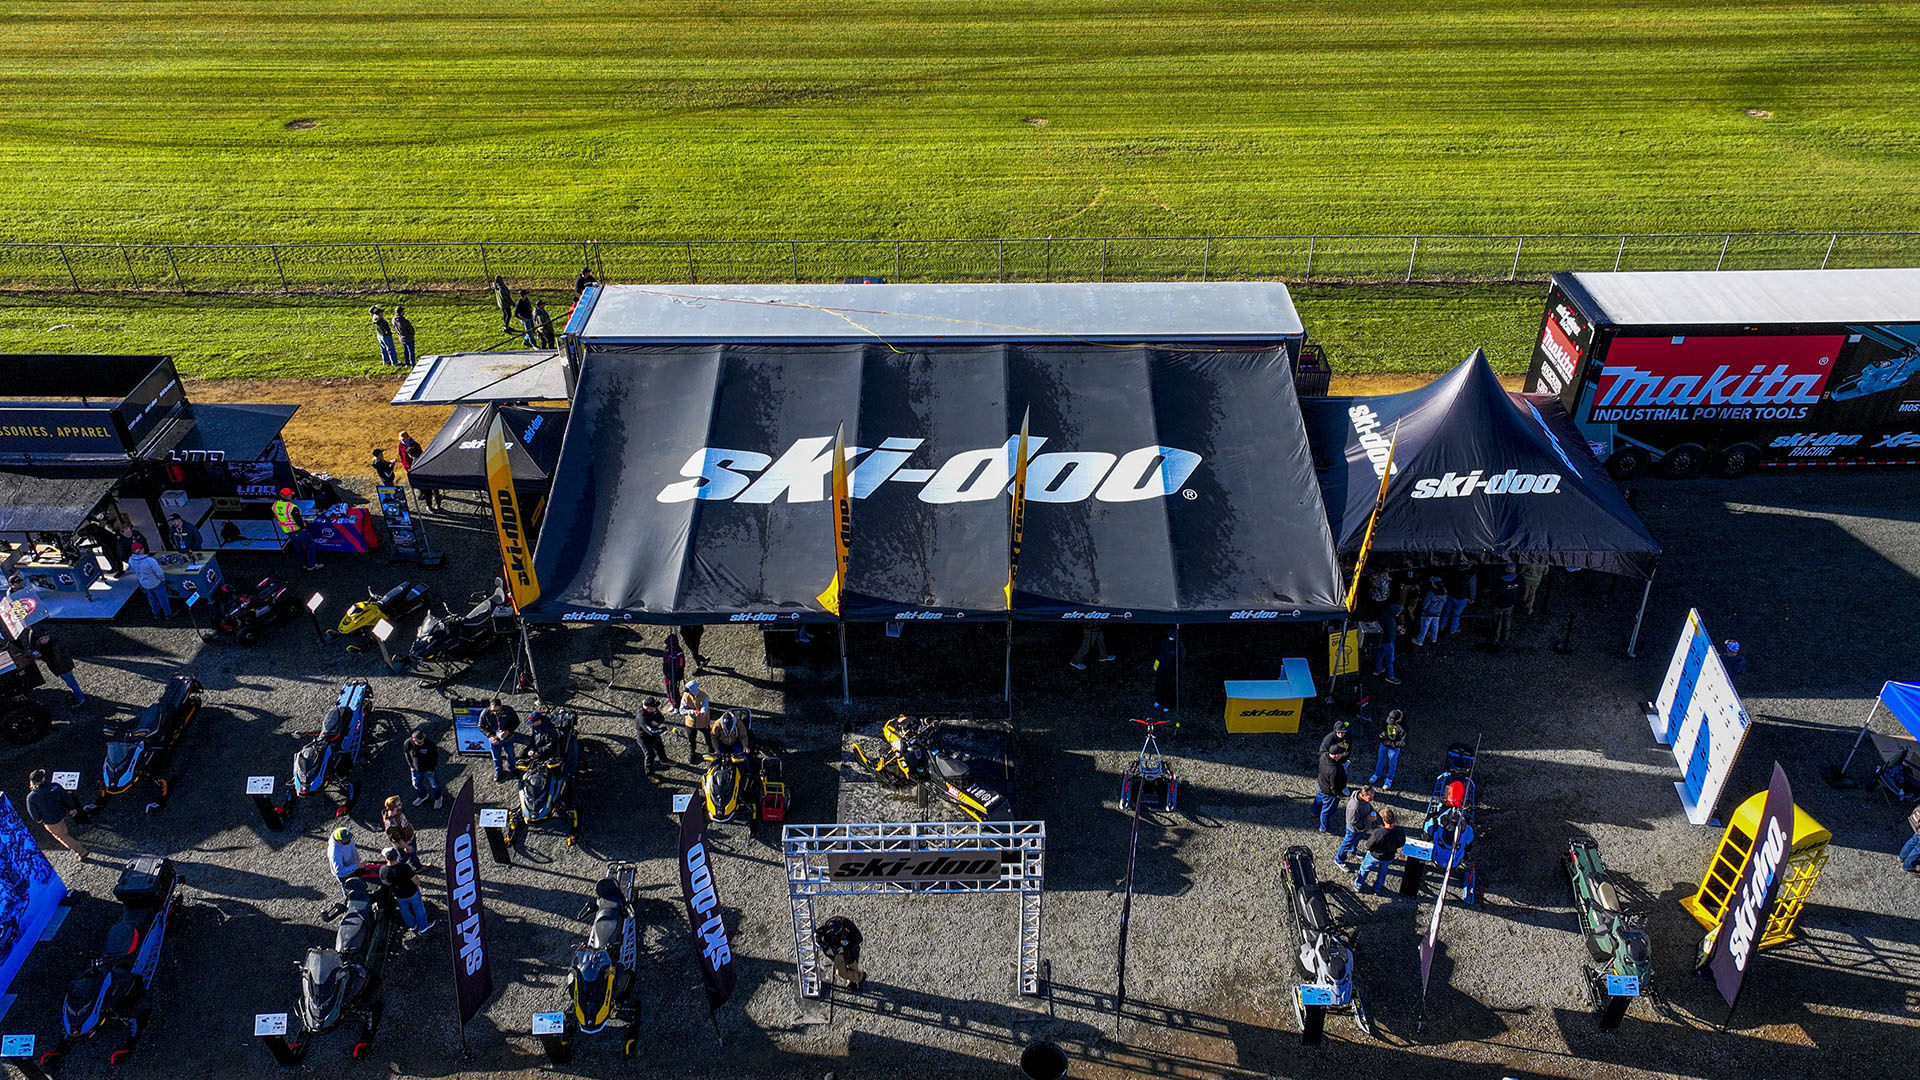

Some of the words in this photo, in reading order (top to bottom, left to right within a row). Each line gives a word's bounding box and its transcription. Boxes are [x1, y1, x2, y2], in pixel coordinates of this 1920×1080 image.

[1592, 407, 1688, 421] INDUSTRIAL
[1692, 407, 1752, 420] POWER
[1755, 406, 1809, 420] TOOLS
[1898, 404, 1920, 412] MOS
[56, 427, 111, 438] APPAREL
[1769, 432, 1863, 447] ski-doo
[1788, 446, 1835, 457] RACING
[657, 435, 1203, 504] ski-doo
[1411, 469, 1561, 499] ski-doo
[1240, 708, 1294, 717] ski-doo
[833, 855, 999, 879] ski-doo
[1730, 815, 1784, 972] ski-doo
[453, 833, 483, 976] ski-doo
[686, 841, 731, 972] ski-doo
